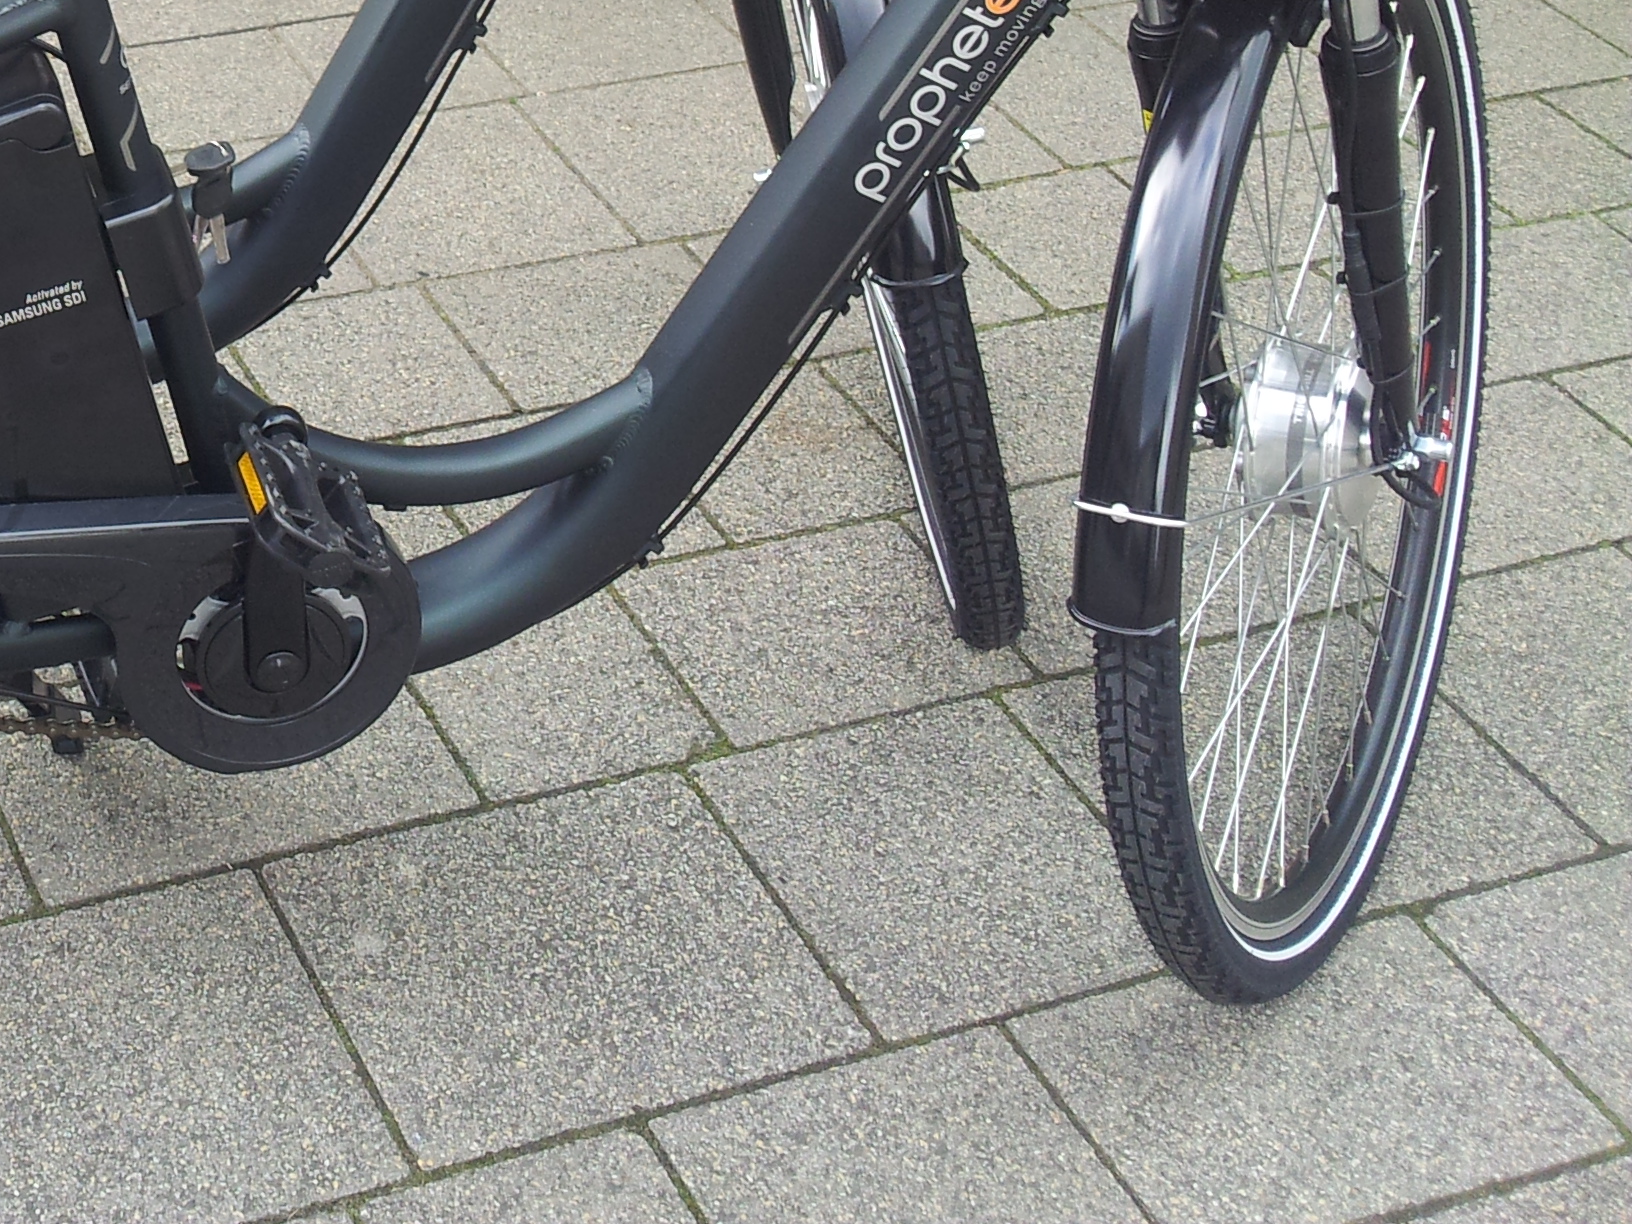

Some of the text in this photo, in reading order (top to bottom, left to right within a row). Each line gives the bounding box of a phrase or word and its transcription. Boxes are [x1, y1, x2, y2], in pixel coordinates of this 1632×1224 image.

[958, 60, 998, 103] keep
[25, 279, 84, 305] Activated by
[64, 290, 87, 308] SDI
